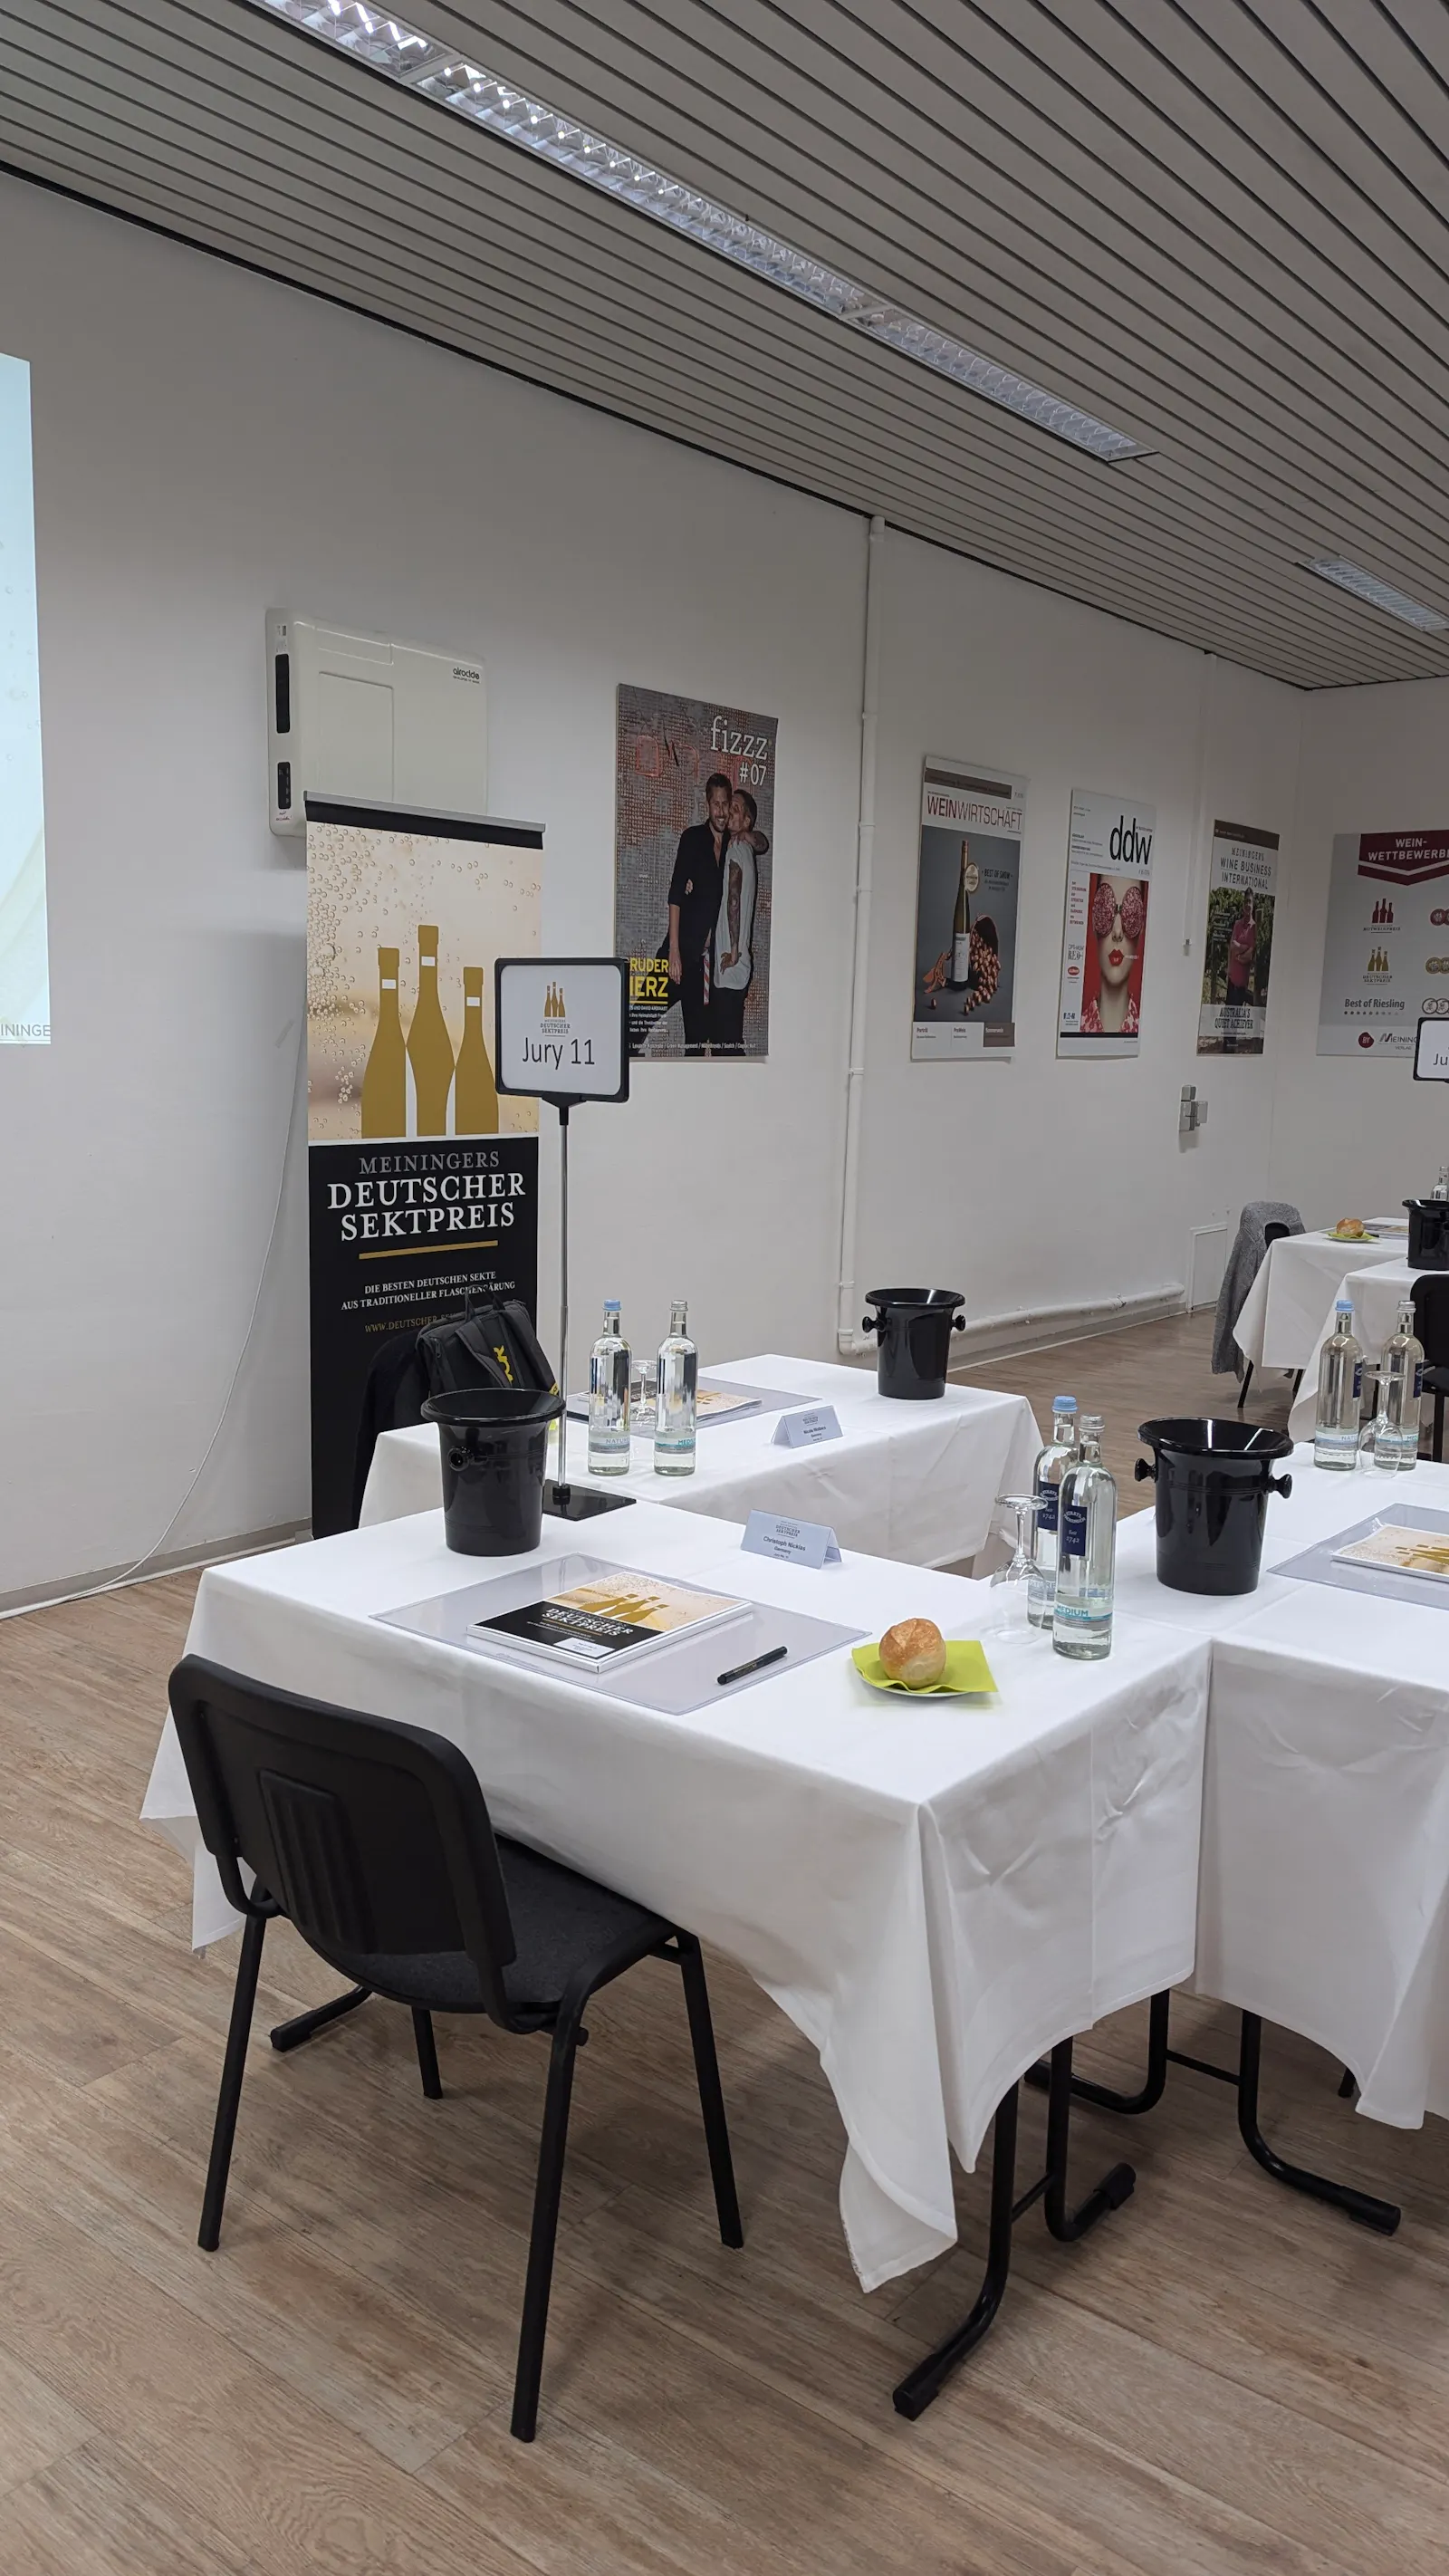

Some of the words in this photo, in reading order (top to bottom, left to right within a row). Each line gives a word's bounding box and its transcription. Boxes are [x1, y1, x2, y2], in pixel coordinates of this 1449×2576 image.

[710, 715, 768, 761] fizzz
[739, 761, 767, 786] #07
[927, 794, 1022, 831] WEINWIRTSCHAFT
[1109, 814, 1153, 865] ddw
[1395, 837, 1428, 848] WEIN-
[1220, 856, 1239, 870] WINE
[1240, 860, 1272, 877] BUSINESS
[1221, 870, 1268, 889] INTERNATIONAL
[629, 957, 669, 974] RUDER
[1344, 998, 1362, 1008] Best
[1363, 998, 1372, 1008] of
[1373, 998, 1406, 1011] Riesling
[523, 1036, 563, 1071] Jury
[571, 1038, 595, 1065] 11
[359, 1150, 500, 1175] MEININGERS
[327, 1172, 526, 1210] DEUTSCHER
[341, 1201, 515, 1242] SEKTPREIS
[364, 1283, 381, 1294] DIE
[381, 1280, 415, 1293] BESTEN
[417, 1273, 468, 1288] DEUTSCHEN
[469, 1271, 496, 1282] SEKTE
[341, 1300, 359, 1311] AUS
[359, 1288, 437, 1309] TRADITIONELLER
[763, 1535, 787, 1547] Christoph
[545, 1608, 634, 1634] DEUTSCHER
[1056, 1603, 1089, 1617] MEDIUM
[542, 1612, 620, 1636] SEKTPREIS
